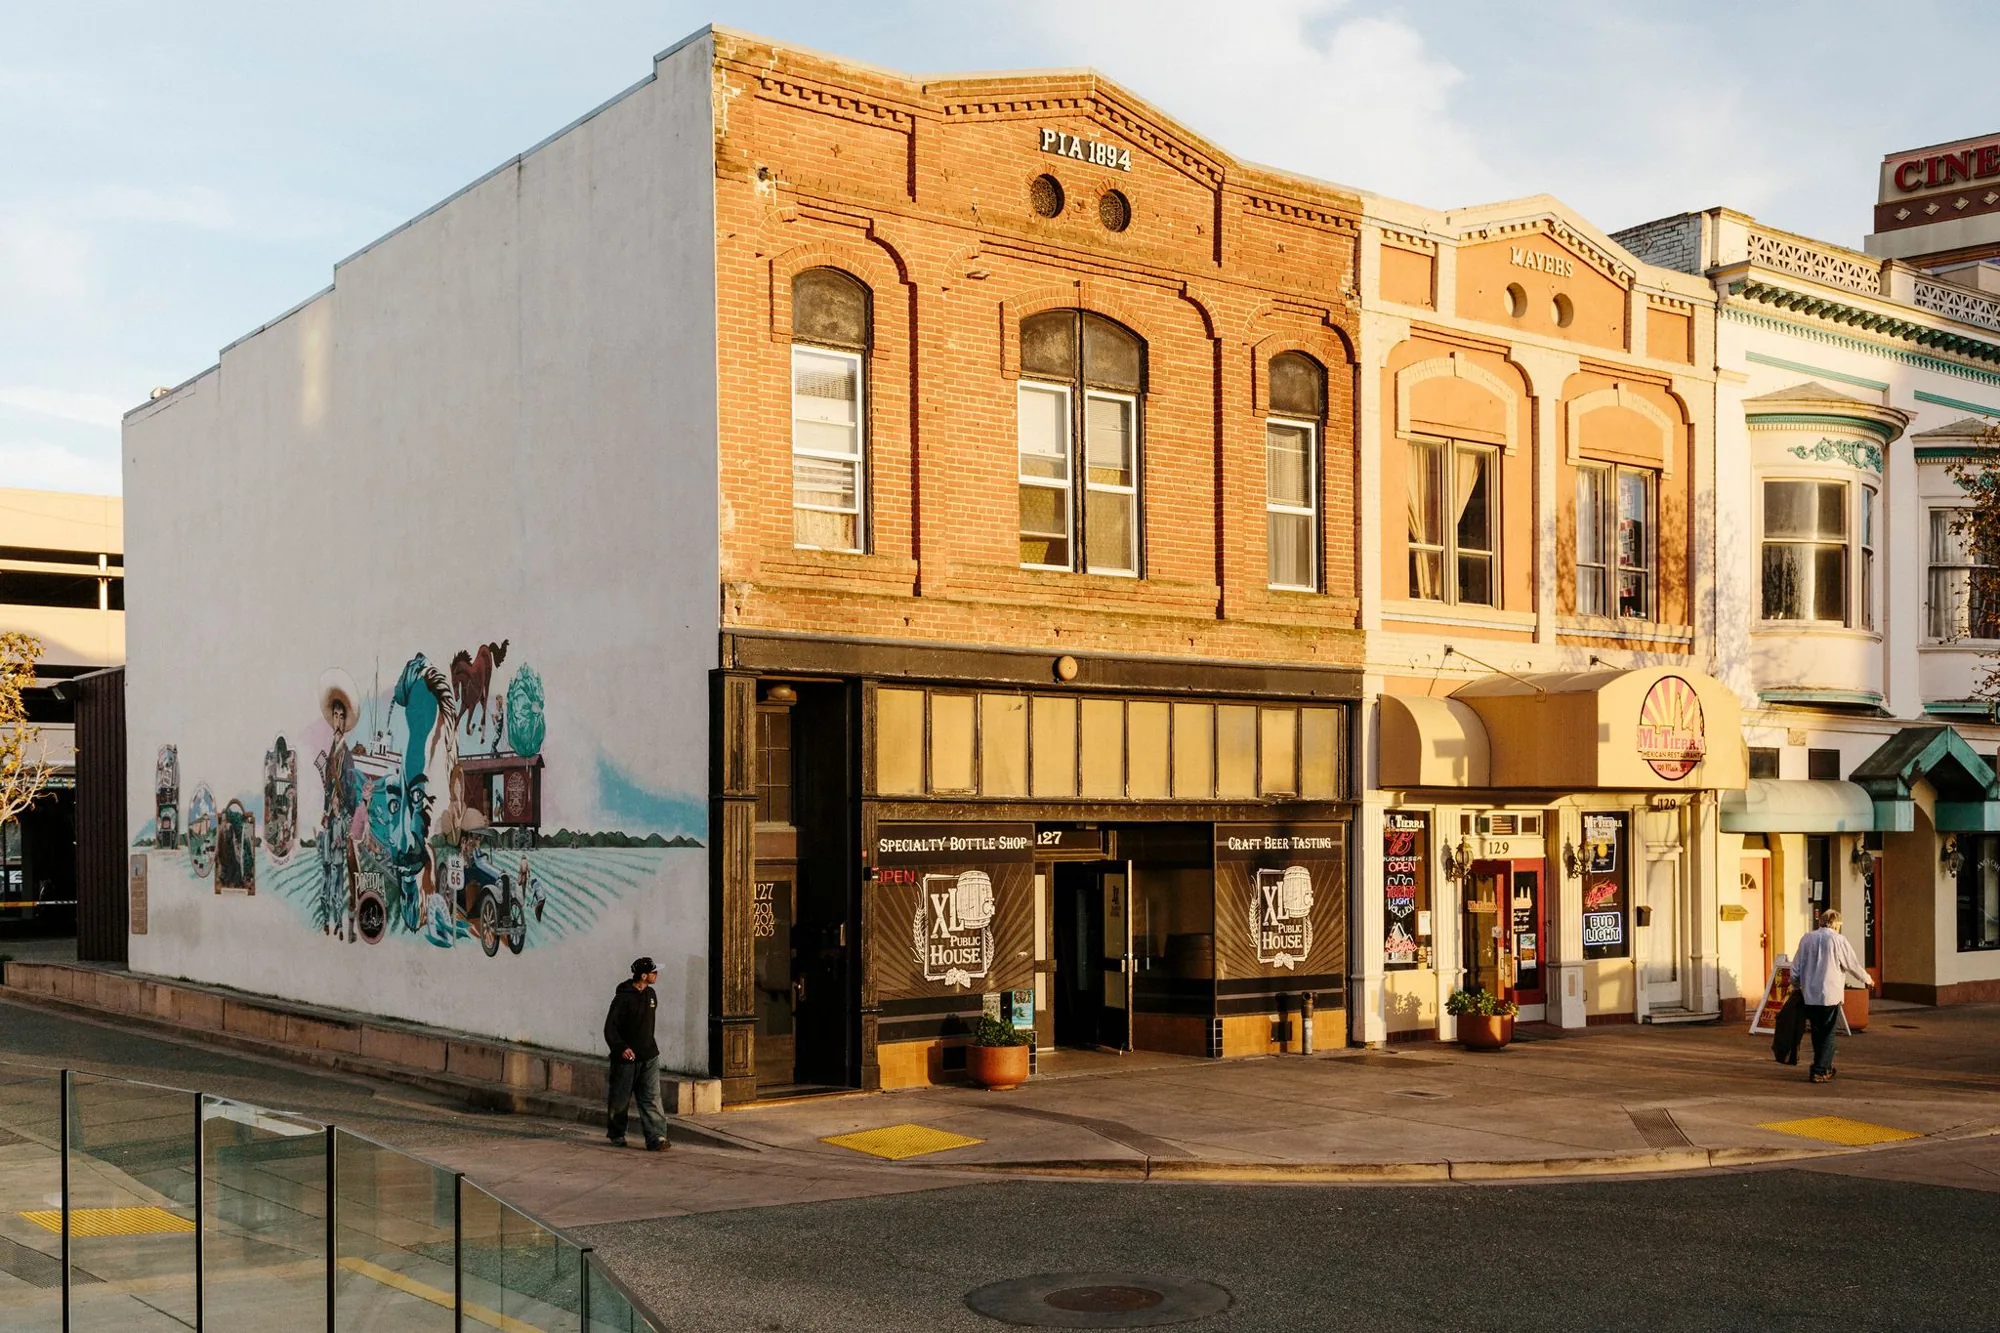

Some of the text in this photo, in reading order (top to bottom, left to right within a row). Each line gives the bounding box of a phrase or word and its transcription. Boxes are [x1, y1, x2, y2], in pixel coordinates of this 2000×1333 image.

[1042, 128, 1131, 171] PIA 1894
[1894, 144, 2000, 192] CINE
[1511, 246, 1574, 278] MAYERS
[1658, 799, 1676, 810] 129
[879, 836, 1027, 852] SPECIALTY BOTTLE SHOP
[1037, 831, 1062, 845] 127
[1228, 836, 1332, 850] CRAFT BEER TASTING
[1489, 841, 1509, 855] 129
[1388, 861, 1416, 872] OPEN
[451, 871, 460, 885] 66
[753, 883, 774, 900] 127
[754, 902, 772, 914] 201
[754, 914, 775, 925] 202
[1590, 915, 1615, 928] BUD
[754, 925, 775, 937] 203
[1278, 923, 1302, 934] PUBLIC
[1586, 927, 1620, 941] LIGHT
[950, 935, 981, 947] PUBLIC
[1263, 931, 1303, 950] HOUSE
[930, 944, 981, 965] HOUSE
